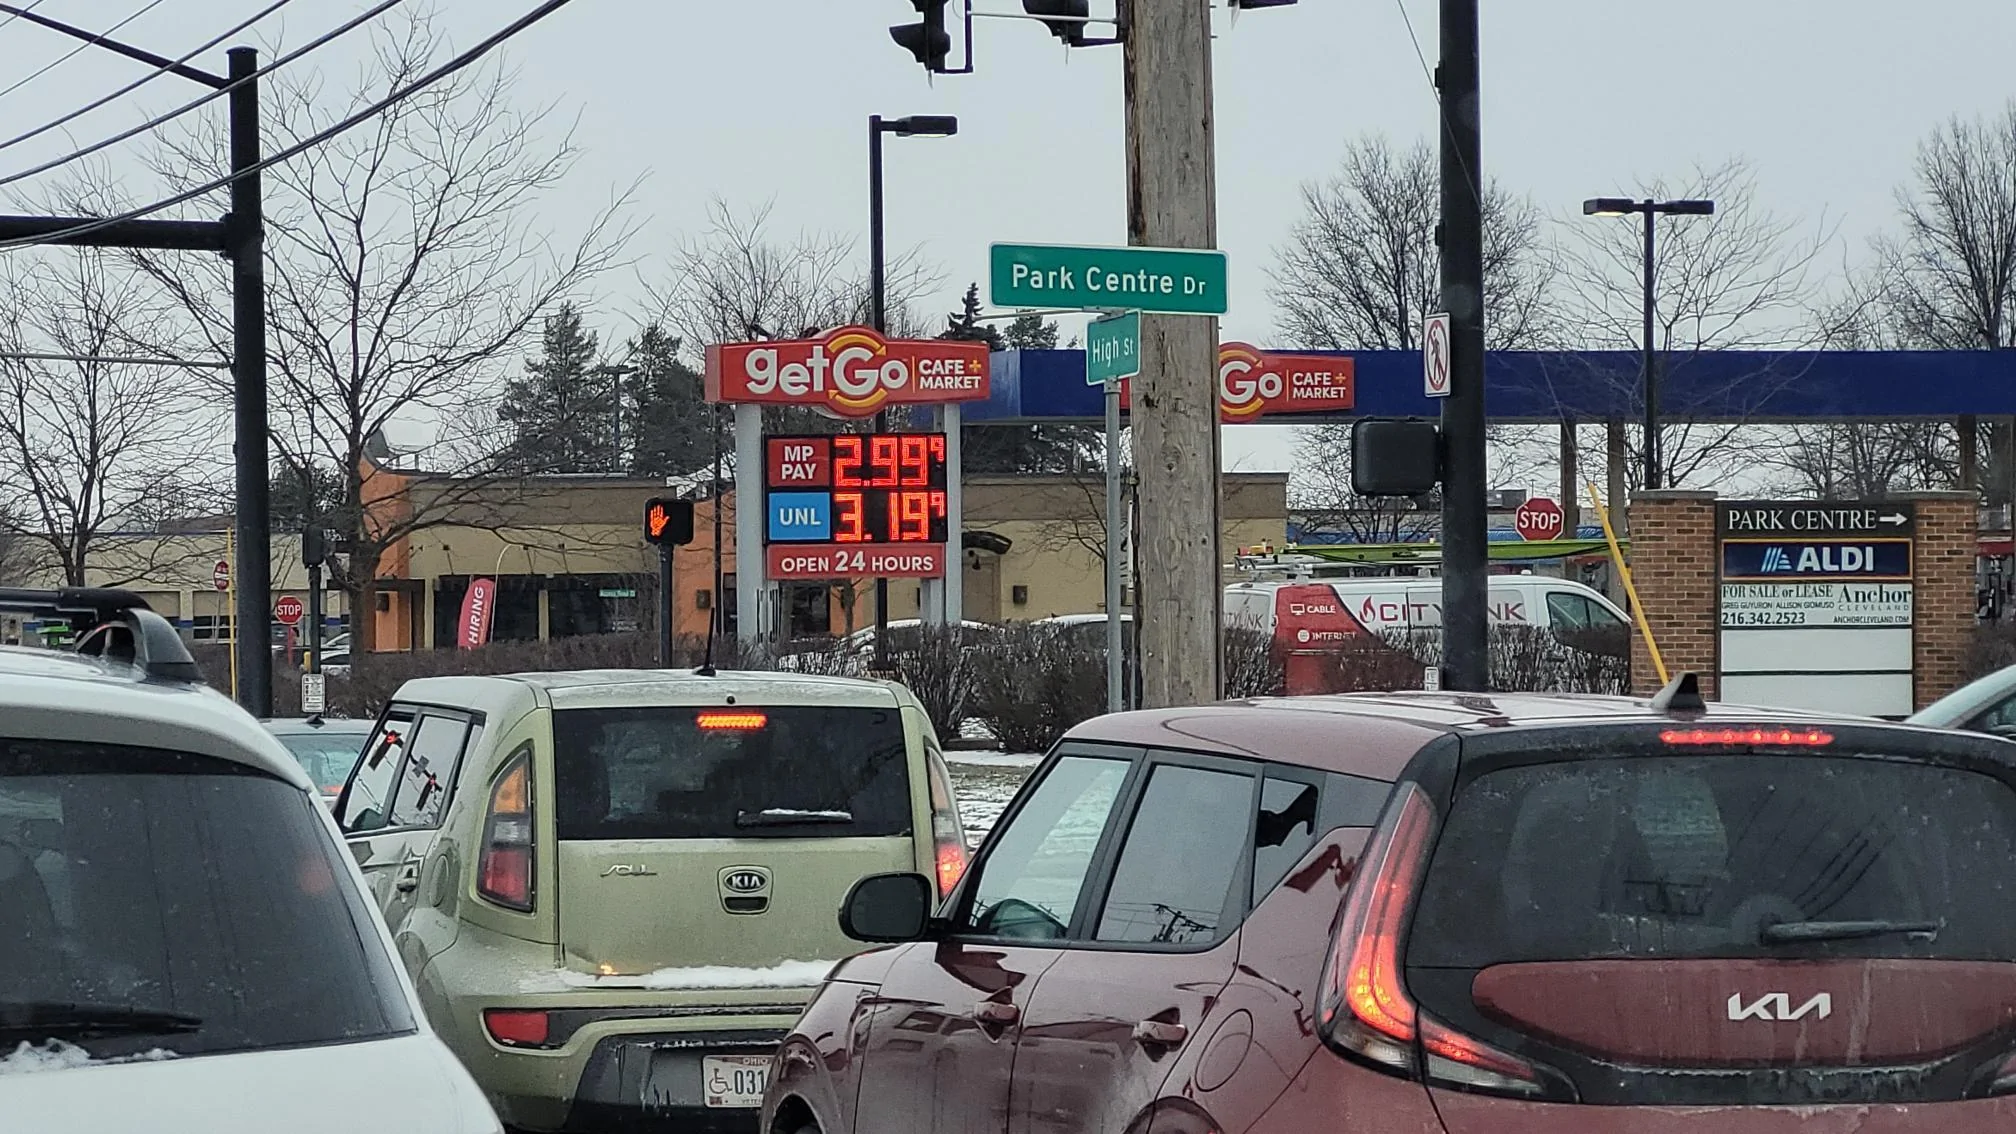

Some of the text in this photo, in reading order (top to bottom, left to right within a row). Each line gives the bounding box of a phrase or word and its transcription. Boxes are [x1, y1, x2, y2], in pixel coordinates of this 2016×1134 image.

[1012, 263, 1206, 295] Park Centre Dr
[1092, 335, 1134, 368] High St
[745, 345, 908, 396] getGo
[919, 359, 965, 375] CAFE
[919, 375, 982, 390] MARKET
[1292, 372, 1332, 386] CAFE
[1292, 386, 1346, 399] MARKET
[784, 446, 814, 462] MP
[781, 463, 817, 480] PAY
[779, 508, 821, 526] UNL
[1518, 511, 1560, 530] STOP
[1728, 509, 1877, 530] PARK CENTRE
[781, 551, 934, 572] OPEN 24 HOURS
[1796, 546, 1874, 572] ALDI
[1722, 584, 1833, 598] FOR SALE or LEASE
[1838, 584, 1912, 603] Anchor
[277, 605, 301, 616] STOP
[1307, 604, 1336, 614] CABLE
[1775, 601, 1802, 609] ALLISON
[467, 585, 485, 645] HIRING
[1722, 612, 1806, 625] 216.342.2523
[1833, 615, 1910, 624] ANCHORCLEVELAND.COM
[731, 875, 761, 888] KIA
[1727, 992, 1831, 1020] KIA
[743, 1057, 768, 1065] OHIO
[734, 1069, 765, 1095] 031
